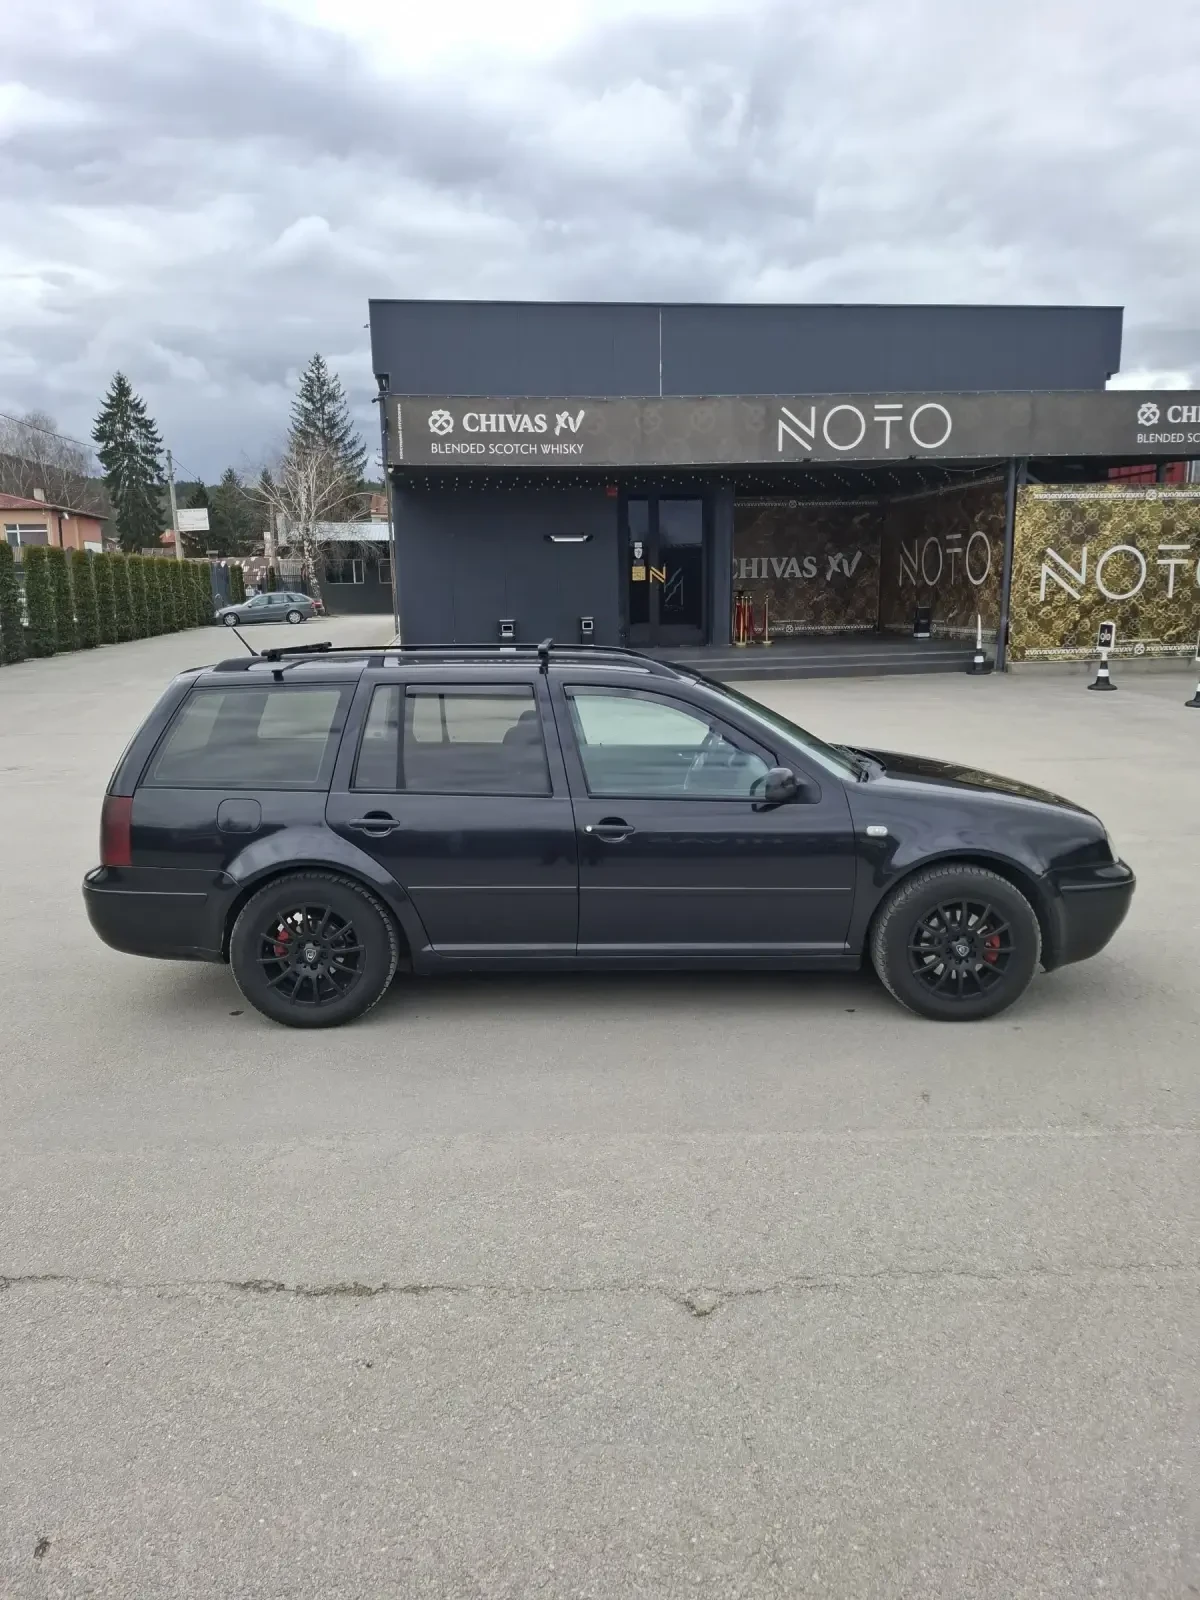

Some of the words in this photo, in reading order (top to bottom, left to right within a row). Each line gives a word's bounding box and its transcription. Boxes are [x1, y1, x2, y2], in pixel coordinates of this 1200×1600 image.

[462, 412, 548, 433] CHIVAS
[554, 409, 586, 436] XV
[778, 403, 952, 452] NOTO
[1137, 433, 1185, 443] BLENDED
[431, 443, 486, 455] BLENDED
[488, 443, 538, 455] SCOTCH
[540, 443, 585, 455] WHISKY
[825, 550, 863, 581] XV
[899, 531, 991, 587] NOTO
[1040, 544, 1200, 601] NOT
